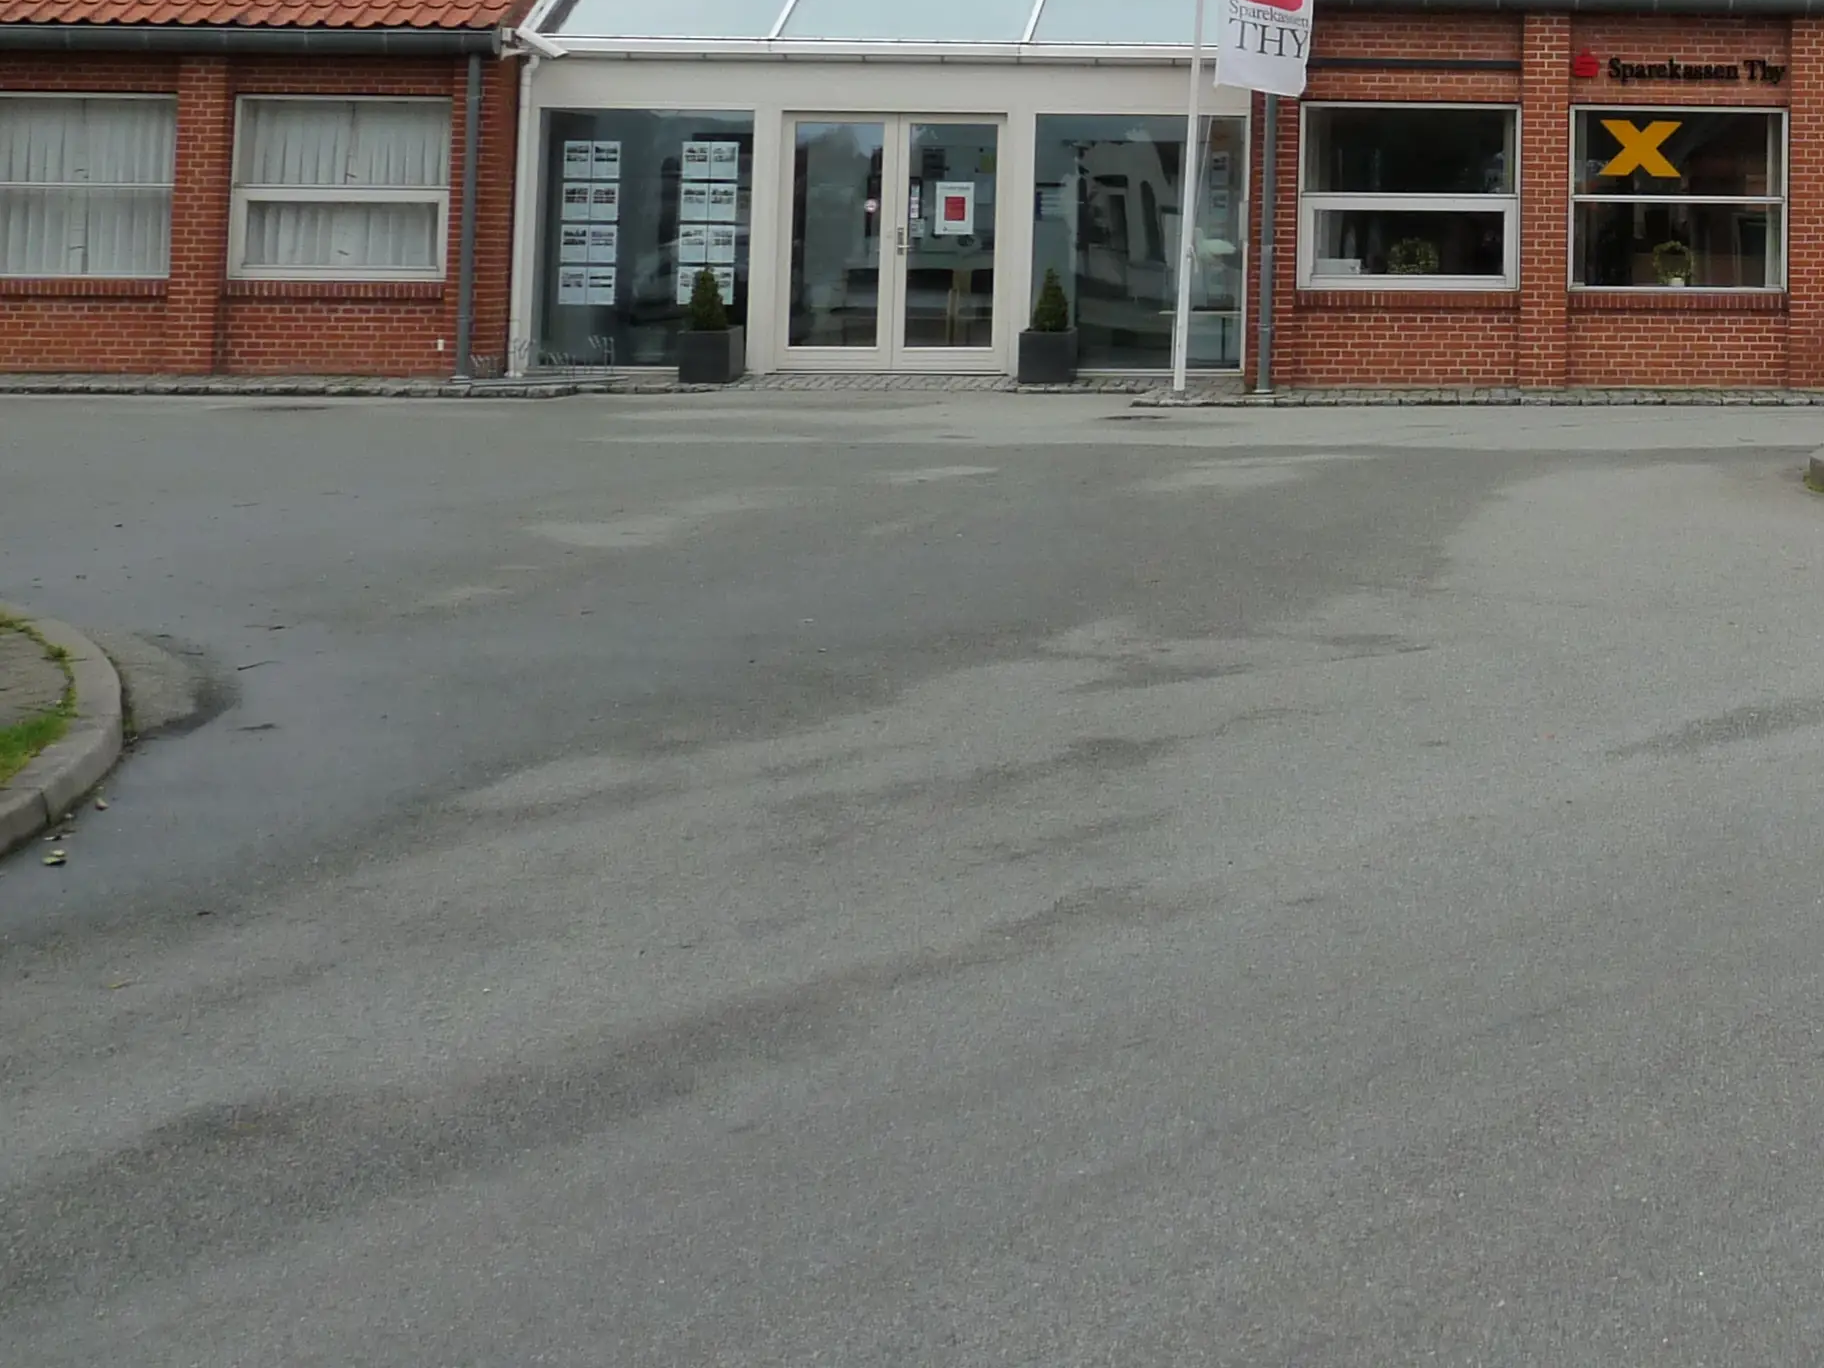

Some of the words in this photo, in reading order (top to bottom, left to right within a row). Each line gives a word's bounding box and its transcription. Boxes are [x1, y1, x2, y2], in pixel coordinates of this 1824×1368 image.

[1229, 18, 1308, 59] THY
[1608, 56, 1739, 84] Sparekassen
[1743, 59, 1786, 84] Thy
